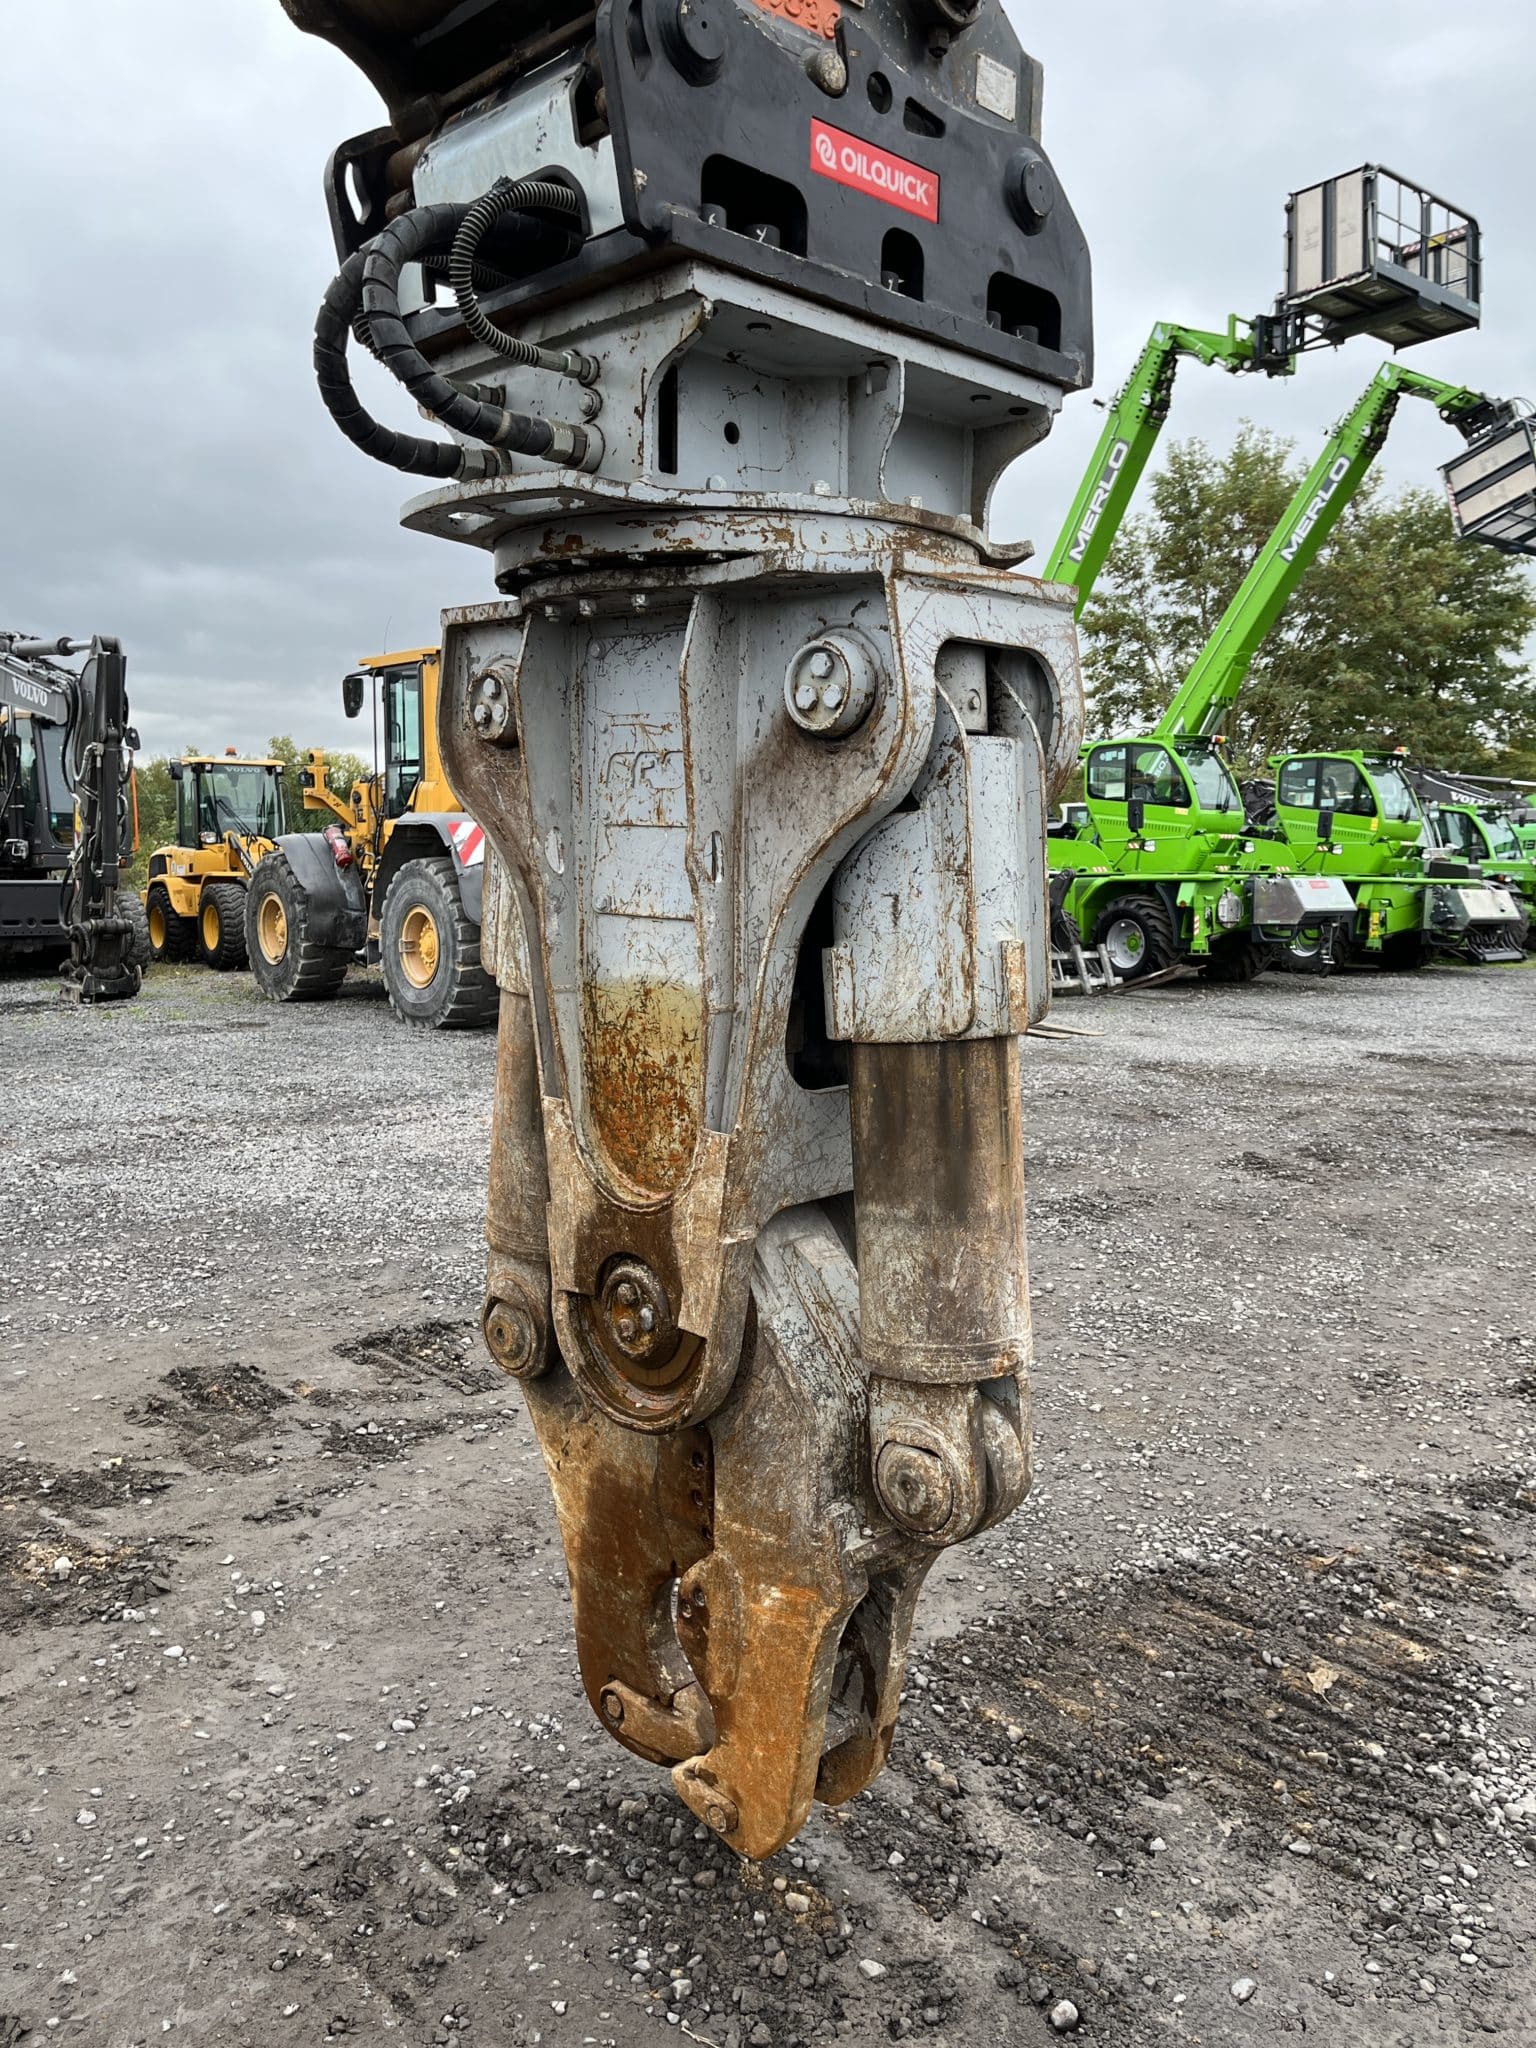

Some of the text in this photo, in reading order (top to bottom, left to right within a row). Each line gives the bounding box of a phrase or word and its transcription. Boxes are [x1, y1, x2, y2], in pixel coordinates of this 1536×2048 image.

[841, 147, 928, 206] OILQUICK
[1069, 441, 1128, 561] MERLO
[1281, 457, 1350, 561] MERLO
[12, 677, 48, 706] VOLVO
[224, 765, 261, 774] VOLVO
